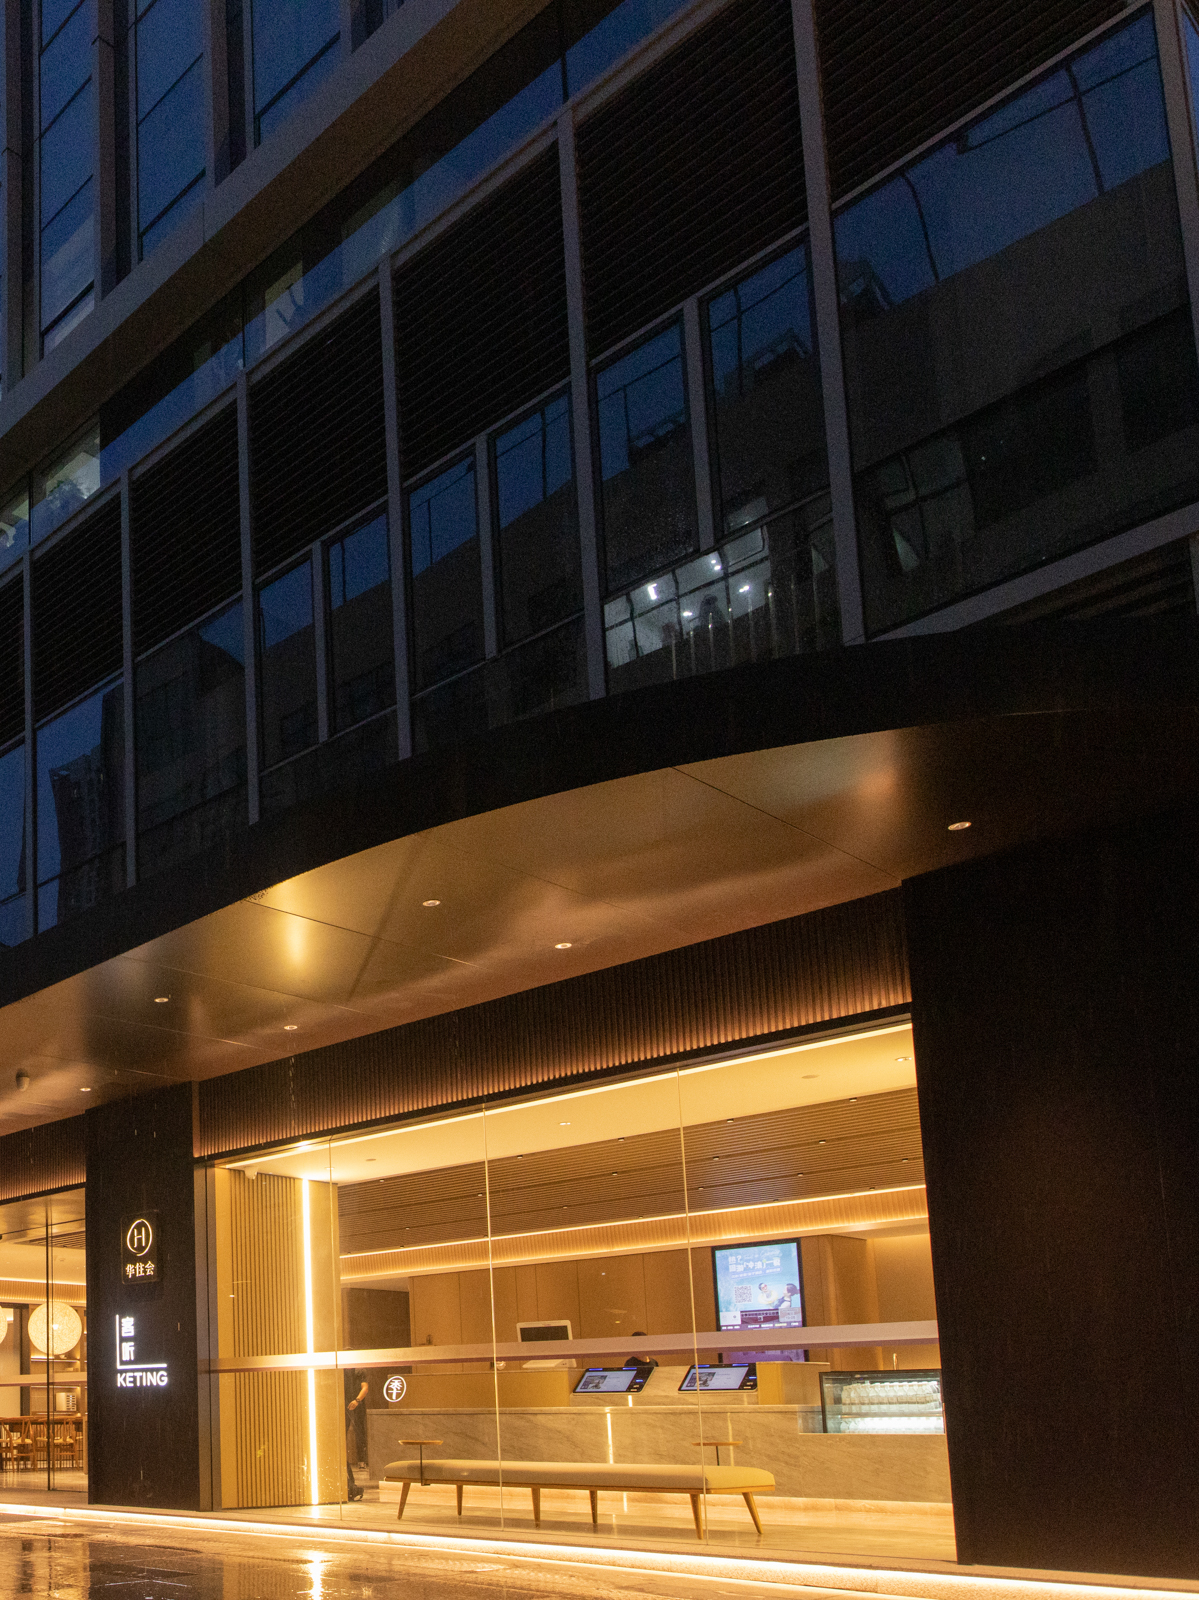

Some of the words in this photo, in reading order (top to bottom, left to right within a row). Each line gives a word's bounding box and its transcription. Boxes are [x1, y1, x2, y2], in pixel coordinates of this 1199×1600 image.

[125, 1261, 155, 1279] 华住会
[117, 1371, 169, 1388] KETING
